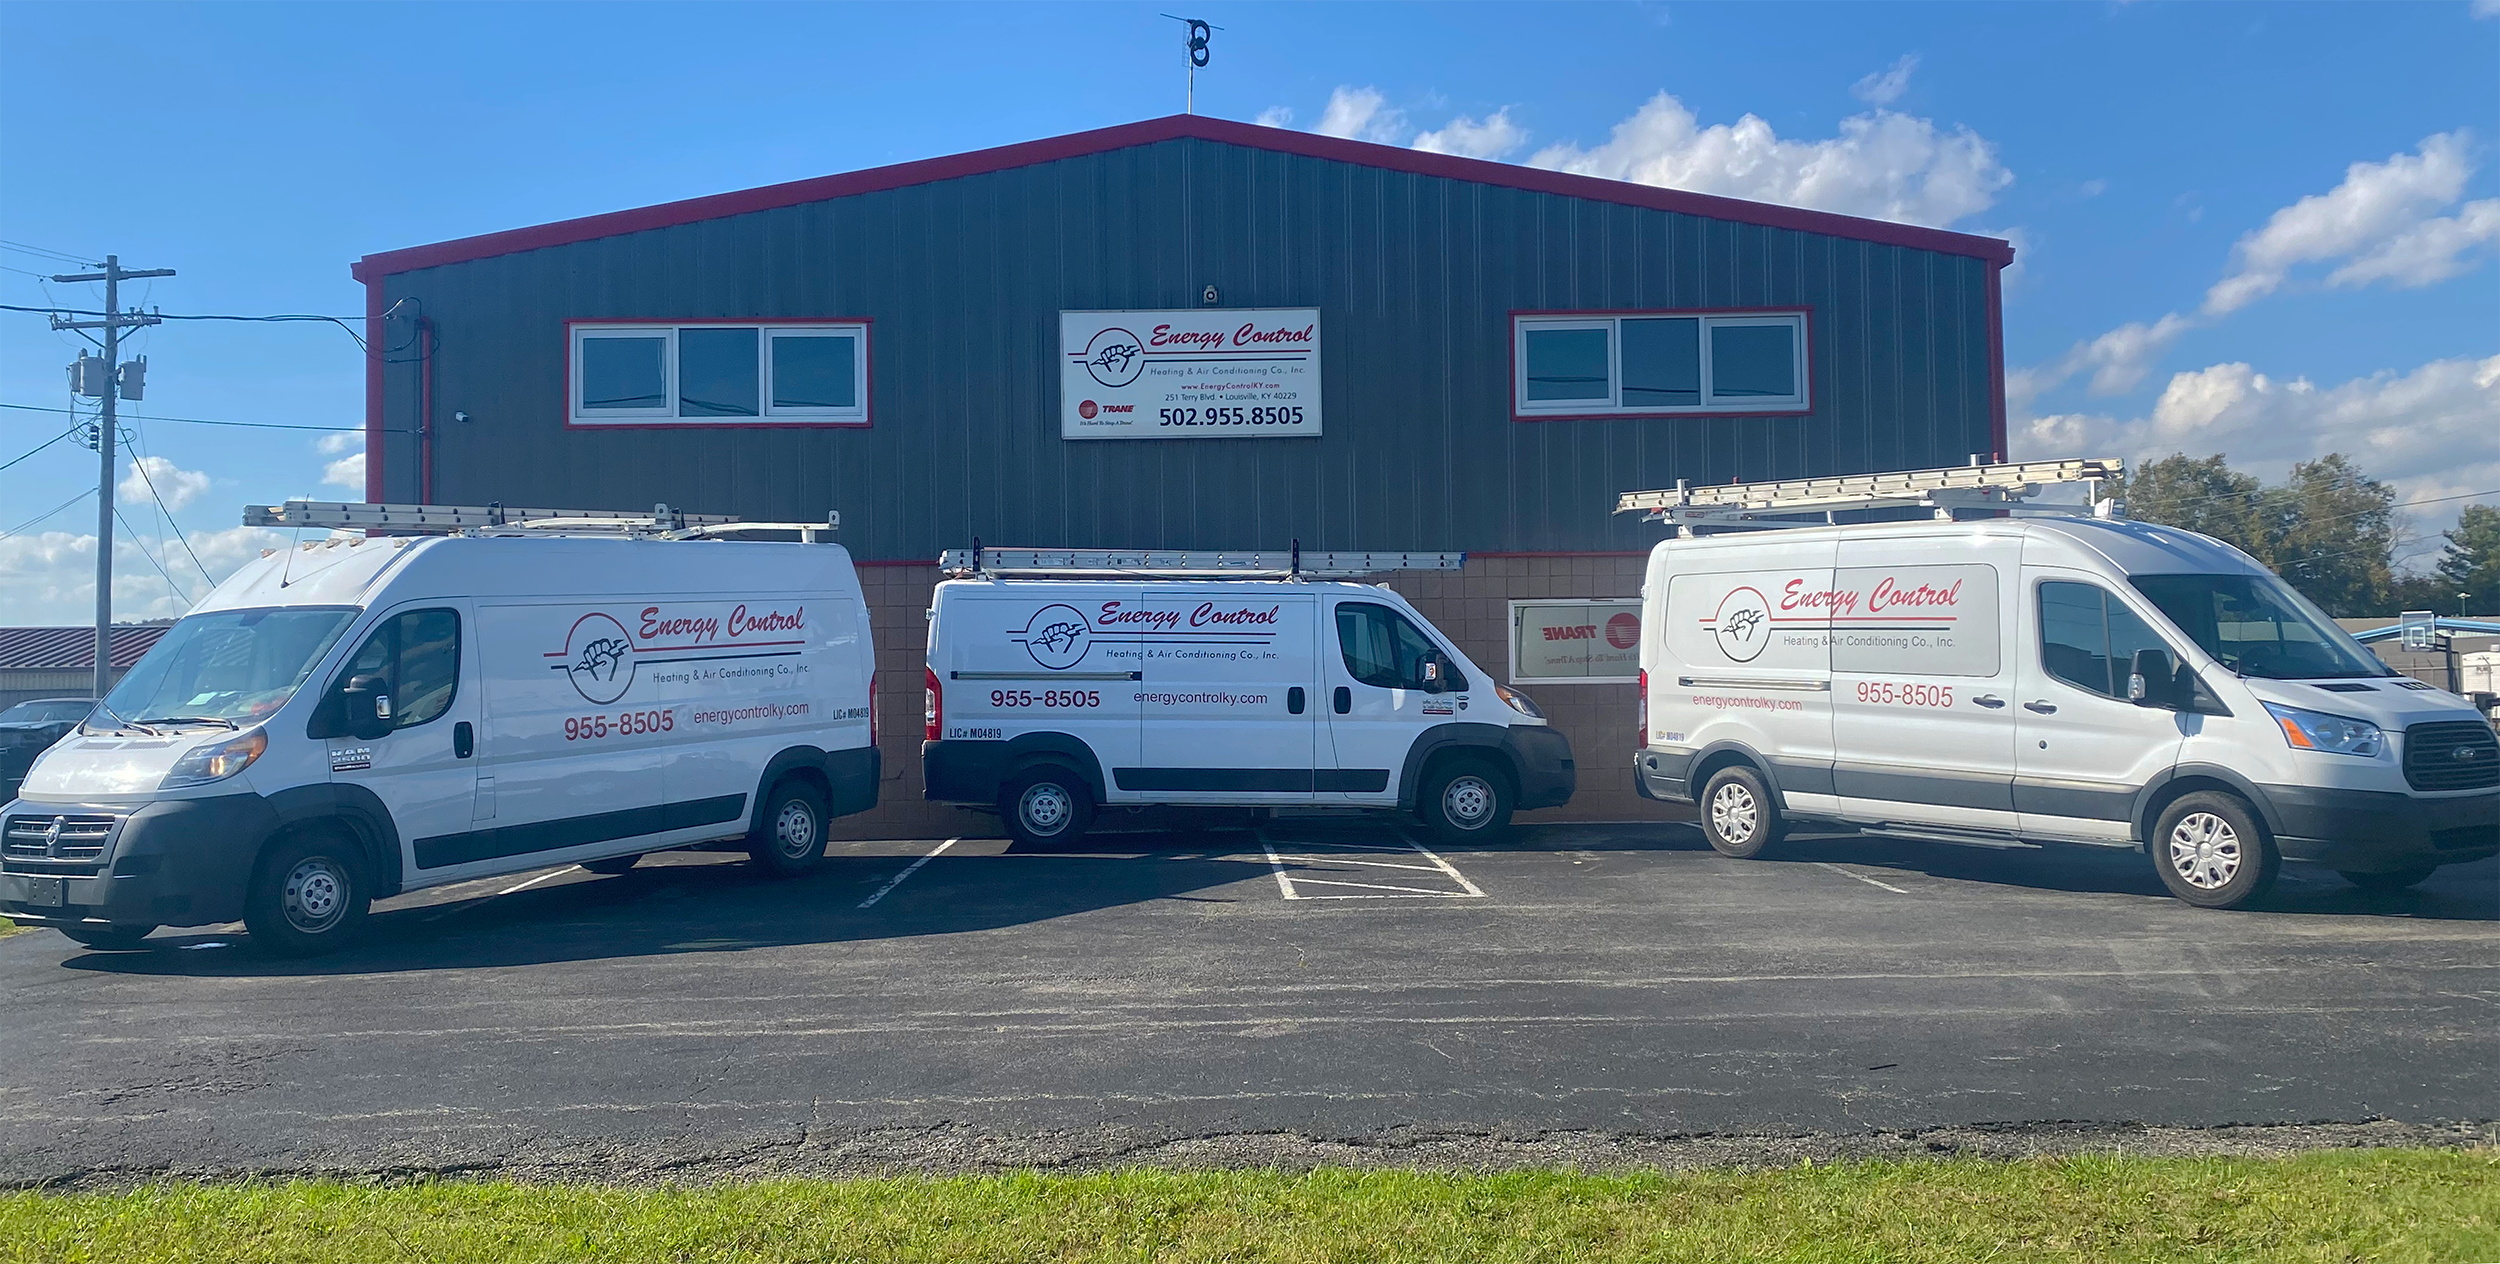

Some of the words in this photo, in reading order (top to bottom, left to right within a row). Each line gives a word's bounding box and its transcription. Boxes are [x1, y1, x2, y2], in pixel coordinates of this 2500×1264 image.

[1150, 324, 1226, 350] Energy
[1233, 323, 1314, 347] Control
[1150, 368, 1184, 377] Heating
[1187, 367, 1193, 375] &
[1196, 367, 1209, 375] Air
[1212, 366, 1267, 376] Conditioning
[1270, 366, 1287, 375] Co.,
[1291, 366, 1306, 374] Inc.
[1181, 382, 1280, 391] www.EnergyControlKY.com
[1181, 394, 1198, 402] Terry
[1200, 393, 1217, 401] Blvd.
[1225, 393, 1259, 401] Louisville,
[1273, 392, 1297, 400] 40229
[1102, 405, 1134, 413] TRANE
[1160, 406, 1303, 426] 502.955.8505
[1780, 578, 1860, 616] Energy
[1869, 576, 1962, 613] Control
[639, 606, 719, 644] Energy
[727, 604, 804, 637] Control
[1098, 601, 1181, 630] Energy
[1190, 601, 1279, 627] Control
[1783, 636, 1819, 648] Heating
[1821, 636, 1828, 645] &
[1830, 635, 1844, 646] Air
[1846, 635, 1908, 649] Conditioning
[1911, 635, 1933, 648] Co.,
[1936, 636, 1956, 647] Inc.
[1106, 649, 1143, 660] Heating
[1147, 650, 1154, 659] &
[1157, 650, 1172, 658] Air
[1175, 650, 1236, 661] Conditioning
[1240, 650, 1259, 660] Co.,
[1262, 651, 1279, 660] Inc.
[653, 672, 690, 684] Heating
[693, 670, 700, 680] &
[703, 669, 716, 680] Air
[719, 666, 774, 679] Conditioning
[777, 664, 794, 675] Co.,
[796, 663, 810, 673] Inc.
[991, 690, 1101, 708] 955-8505
[1133, 691, 1268, 706] energycontrolky.com
[1692, 694, 1803, 712] energycontrolky.com
[1857, 681, 1954, 708] 955-8505
[694, 702, 809, 725] energycontrolky.com
[564, 709, 674, 741] 955-8505
[950, 728, 968, 738] LIC#
